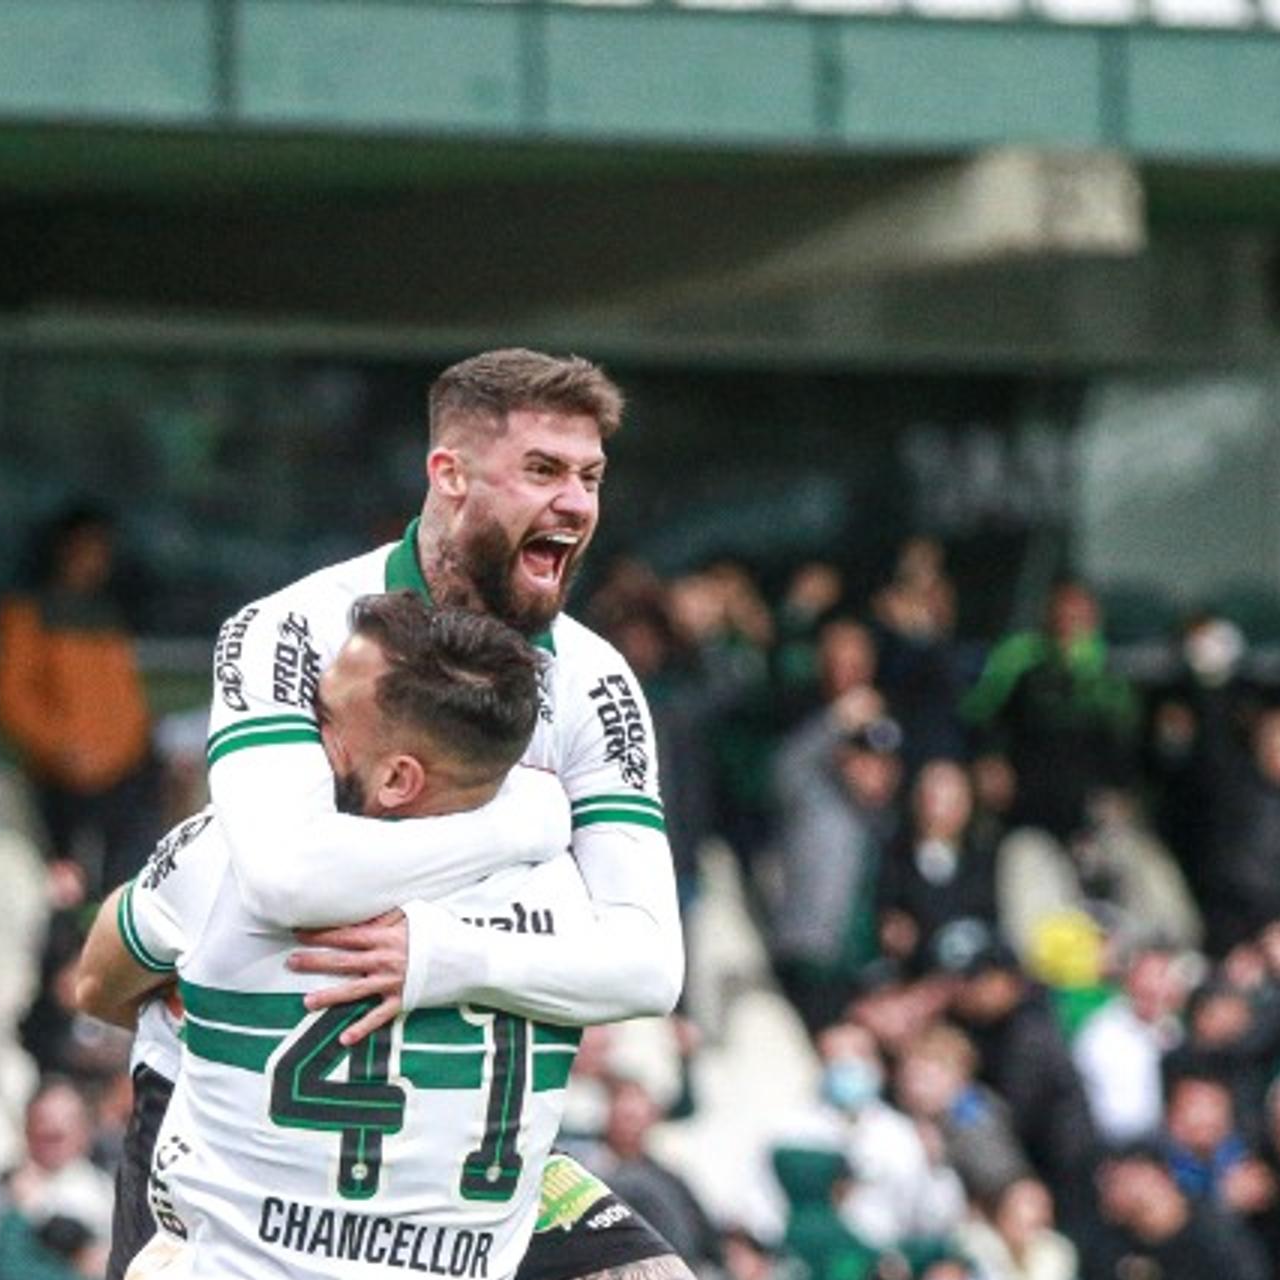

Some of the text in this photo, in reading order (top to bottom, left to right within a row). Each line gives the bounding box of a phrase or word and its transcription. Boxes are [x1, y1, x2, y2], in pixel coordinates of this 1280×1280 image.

[273, 641, 299, 706] PRO
[606, 673, 645, 743] PRO
[588, 677, 626, 763] TORK
[269, 992, 527, 1201] 41
[257, 1196, 495, 1279] CHANCELLOR
